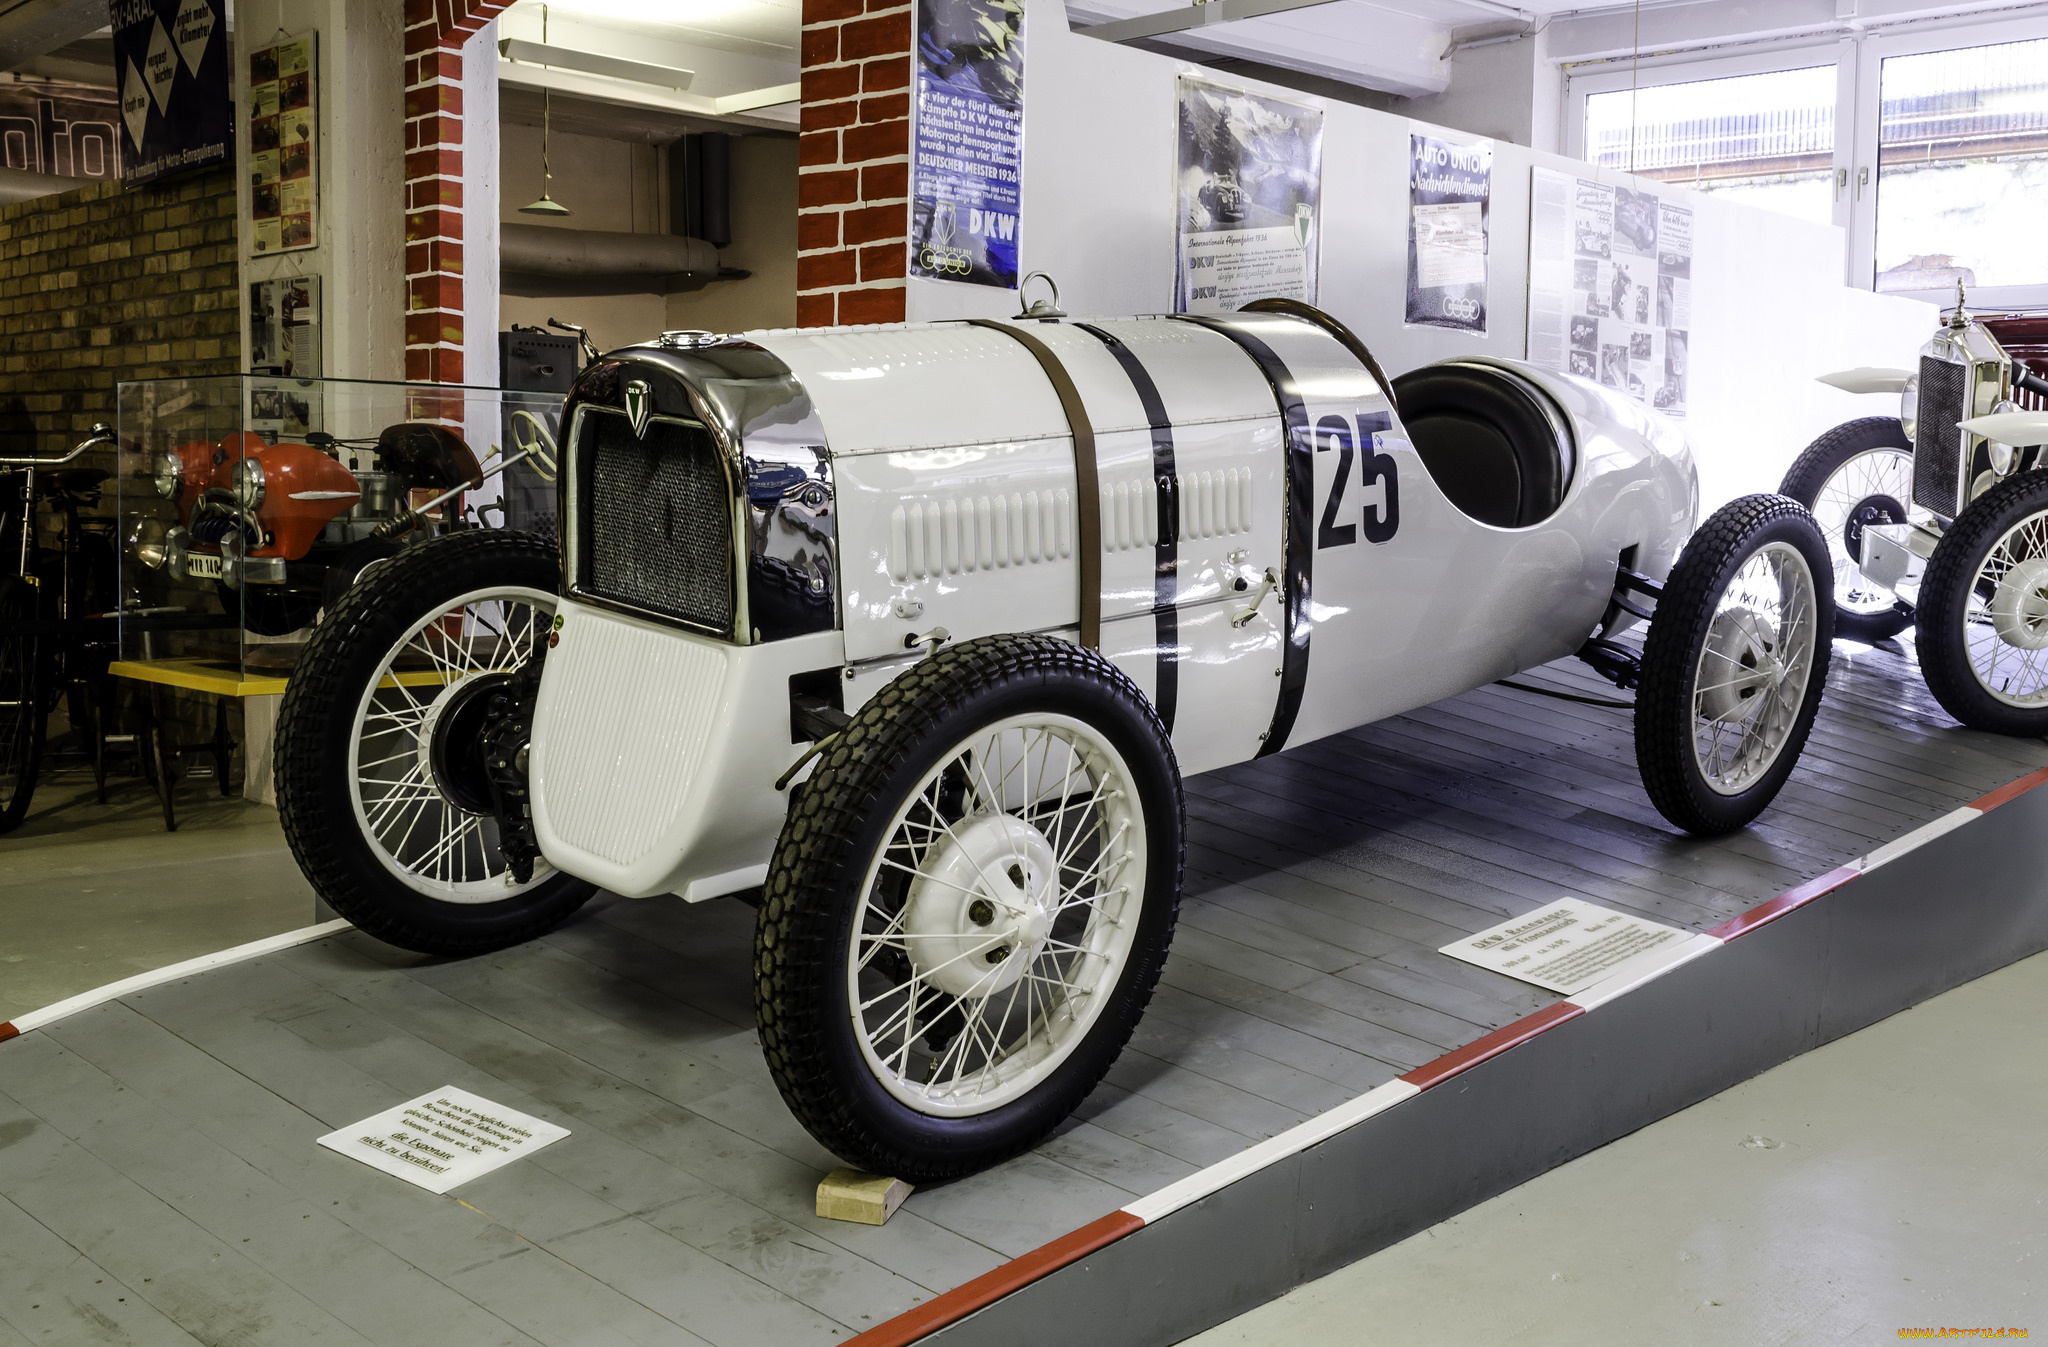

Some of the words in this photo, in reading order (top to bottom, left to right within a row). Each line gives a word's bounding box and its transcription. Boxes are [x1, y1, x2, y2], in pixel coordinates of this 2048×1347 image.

[177, 8, 192, 28] ergibt
[193, 3, 208, 20] mehr
[180, 24, 210, 44] Kilometer
[920, 102, 958, 118] kämpfte
[989, 118, 1003, 129] um
[1005, 121, 1018, 132] die
[932, 92, 949, 104] vier
[952, 96, 966, 108] der
[968, 99, 986, 113] fünf
[988, 104, 1019, 120] Klassen
[920, 112, 954, 130] höchsten
[954, 120, 974, 134] Ehren
[976, 126, 985, 136] im
[986, 128, 1017, 144] deutschen
[920, 125, 1001, 151] Motorrad-Rennsport
[1003, 144, 1018, 156] und
[919, 152, 964, 172] DEUTSCHER
[966, 161, 998, 180] MEISTER
[999, 168, 1016, 183] 1936
[920, 140, 946, 152] wurde
[947, 143, 954, 154] in
[956, 146, 974, 159] allen
[976, 150, 990, 161] vier
[991, 152, 1016, 167] Klassen
[1416, 144, 1448, 166] AUTO
[1451, 152, 1486, 175] UNION
[970, 208, 1015, 241] DKW
[1188, 237, 1224, 248] Internationale
[1226, 235, 1254, 246] Alpenfahrt
[1189, 255, 1216, 269] DKW
[1192, 286, 1216, 300] DKW
[1316, 410, 1399, 549] 25
[1501, 943, 1520, 951] mit
[1515, 918, 1578, 943] Frontantrieb
[403, 1109, 436, 1122] gleicher
[434, 1120, 474, 1137] Schönheit
[472, 1136, 499, 1148] zeigen
[422, 1103, 461, 1121] Besuchern
[473, 1123, 513, 1140] Fahrzeuge
[436, 1098, 451, 1106] Um
[450, 1105, 471, 1114] noch
[469, 1112, 509, 1128] möglichst
[508, 1127, 532, 1138] vielen
[391, 1132, 409, 1141] die
[408, 1138, 455, 1160] Exponate
[431, 1131, 455, 1143] bitten
[360, 1136, 387, 1148] nicht
[399, 1150, 451, 1173] berühren!
